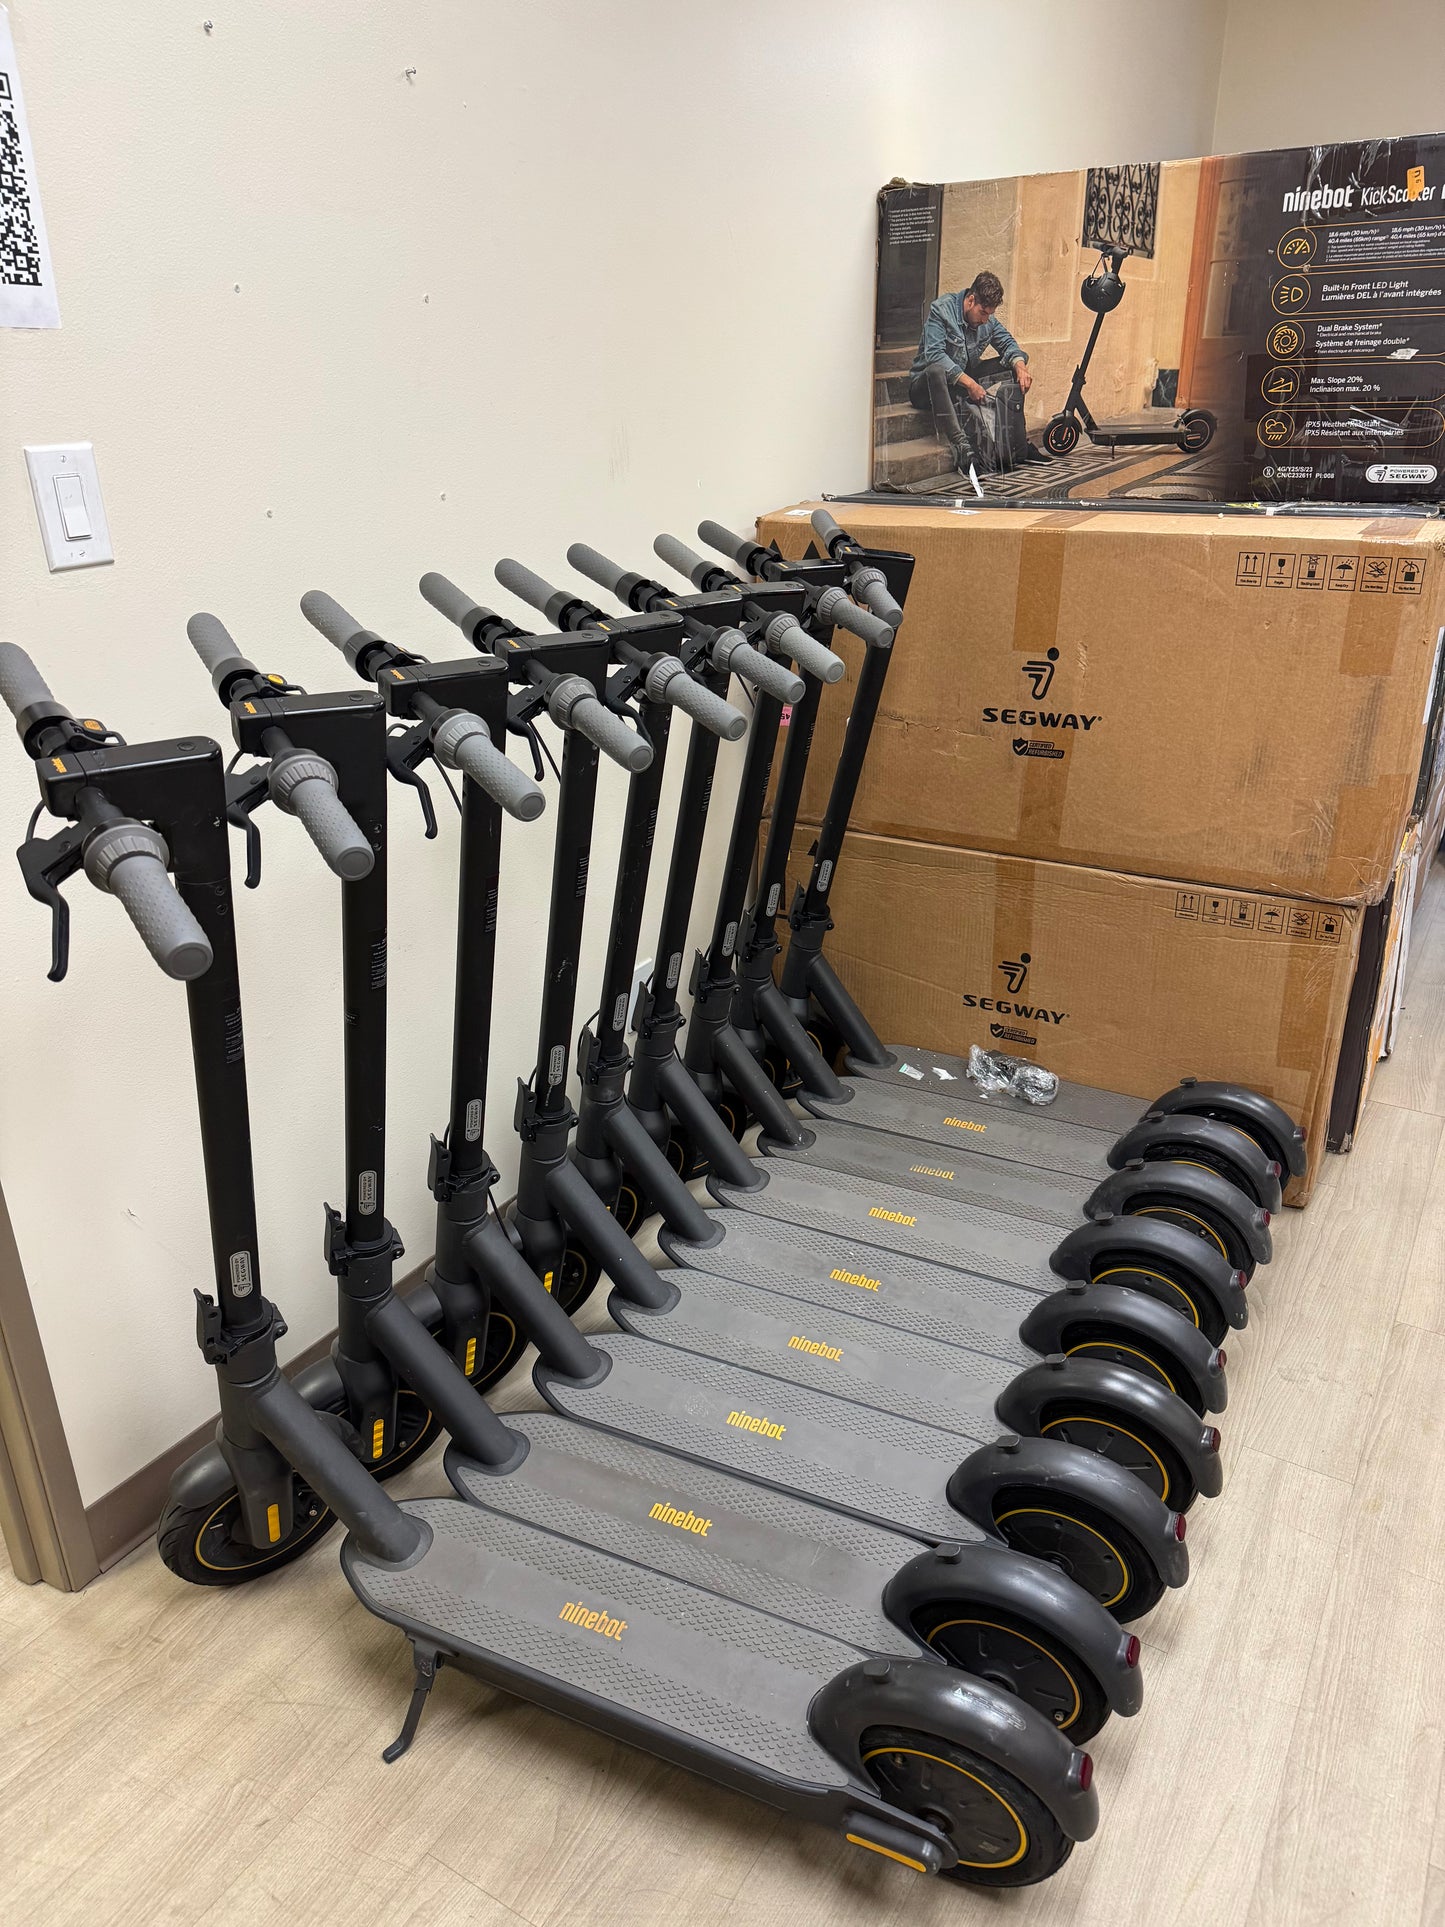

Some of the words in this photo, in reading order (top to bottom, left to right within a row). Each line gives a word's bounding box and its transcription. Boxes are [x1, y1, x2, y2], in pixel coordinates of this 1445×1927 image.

[1283, 184, 1355, 212] ninebot
[1361, 185, 1436, 206] KickScoer
[1321, 292, 1355, 301] Lumières
[1356, 292, 1372, 300] DEL
[1406, 288, 1442, 298] intégrées
[1323, 284, 1349, 292] Built-In
[1389, 281, 1408, 290] Light
[1317, 324, 1332, 332] Dual
[1334, 324, 1352, 332] Brake
[1315, 340, 1344, 348] Système
[1355, 338, 1382, 346] freinage
[1328, 376, 1346, 384] Slope
[1306, 420, 1320, 428] IPX5
[1322, 420, 1347, 428] Weather
[982, 708, 1099, 731] SEGWAY
[963, 994, 1066, 1024] SEGWAY
[943, 1117, 988, 1133] ninebot
[868, 1207, 917, 1227] ninebot
[829, 1268, 882, 1292] ninebot
[787, 1335, 844, 1362] ninebot
[725, 1410, 787, 1441] ninebot
[648, 1502, 713, 1537] ninebot
[558, 1601, 628, 1641] ninebot
